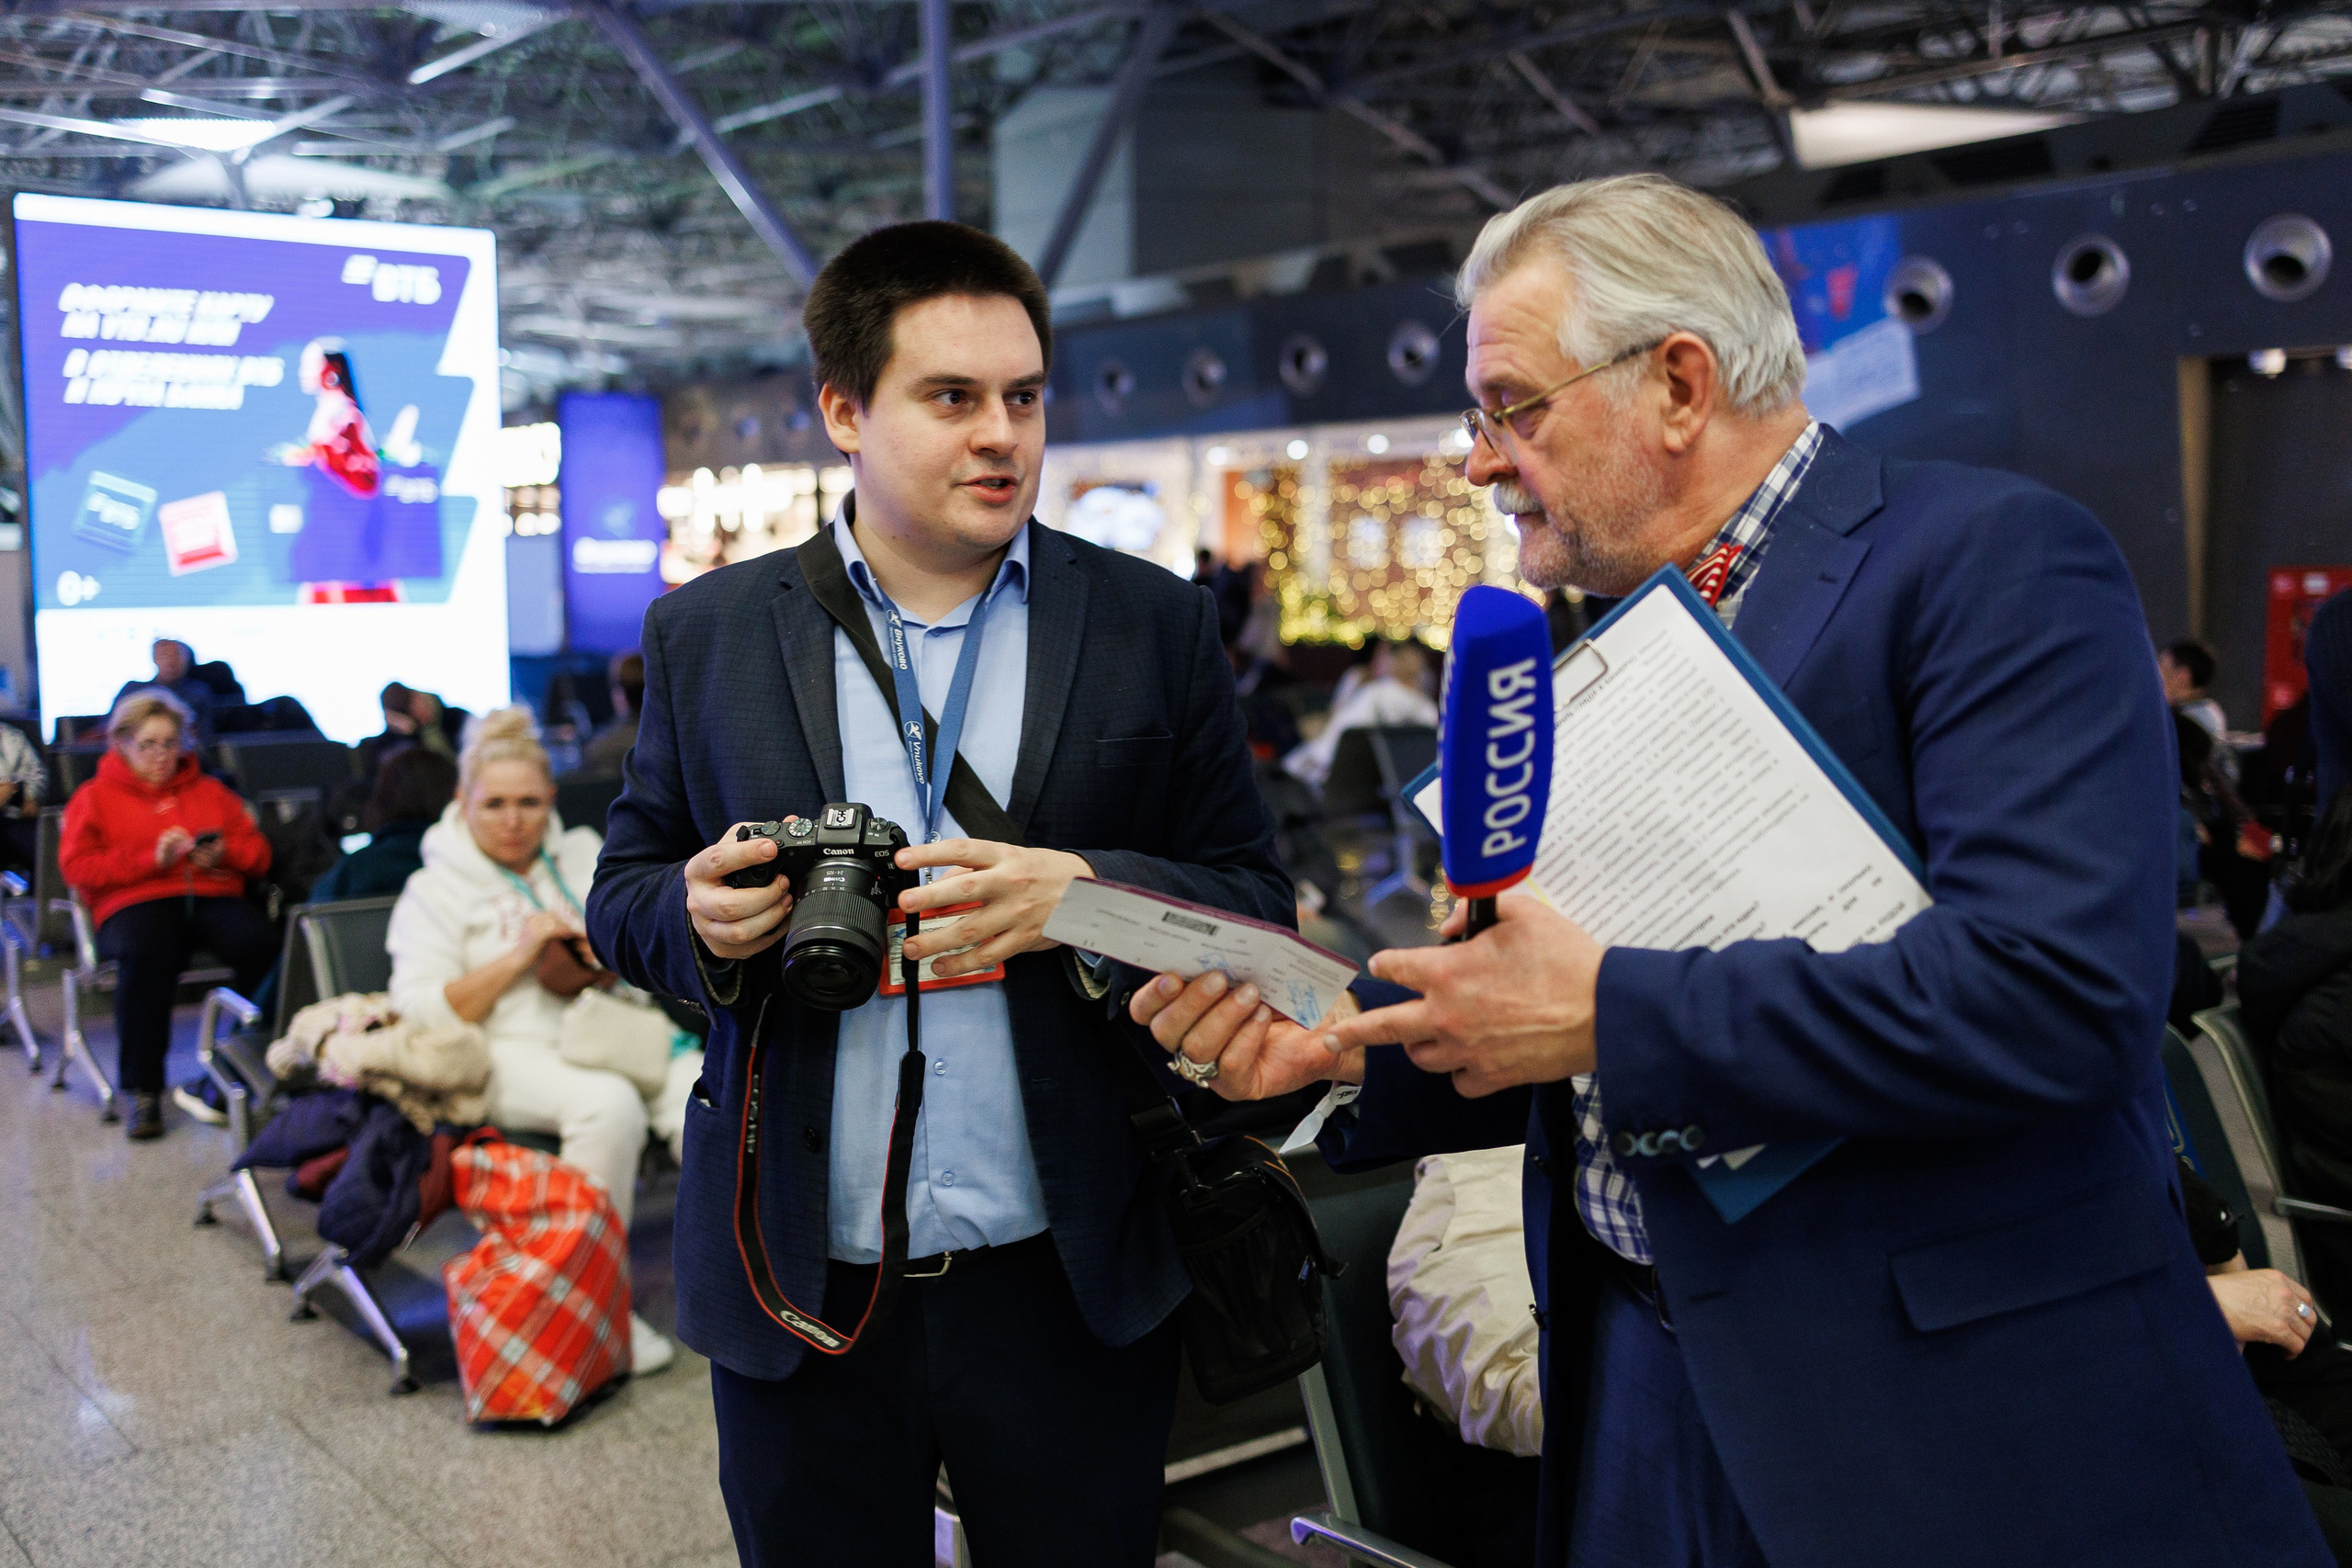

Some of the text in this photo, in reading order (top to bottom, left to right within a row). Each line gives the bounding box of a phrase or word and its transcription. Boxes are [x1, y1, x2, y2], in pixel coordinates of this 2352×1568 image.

[912, 741, 925, 784] Vnukovo
[1481, 657, 1537, 858] РОССИЯ
[874, 850, 890, 858] EOS
[779, 1309, 841, 1348] Canon
